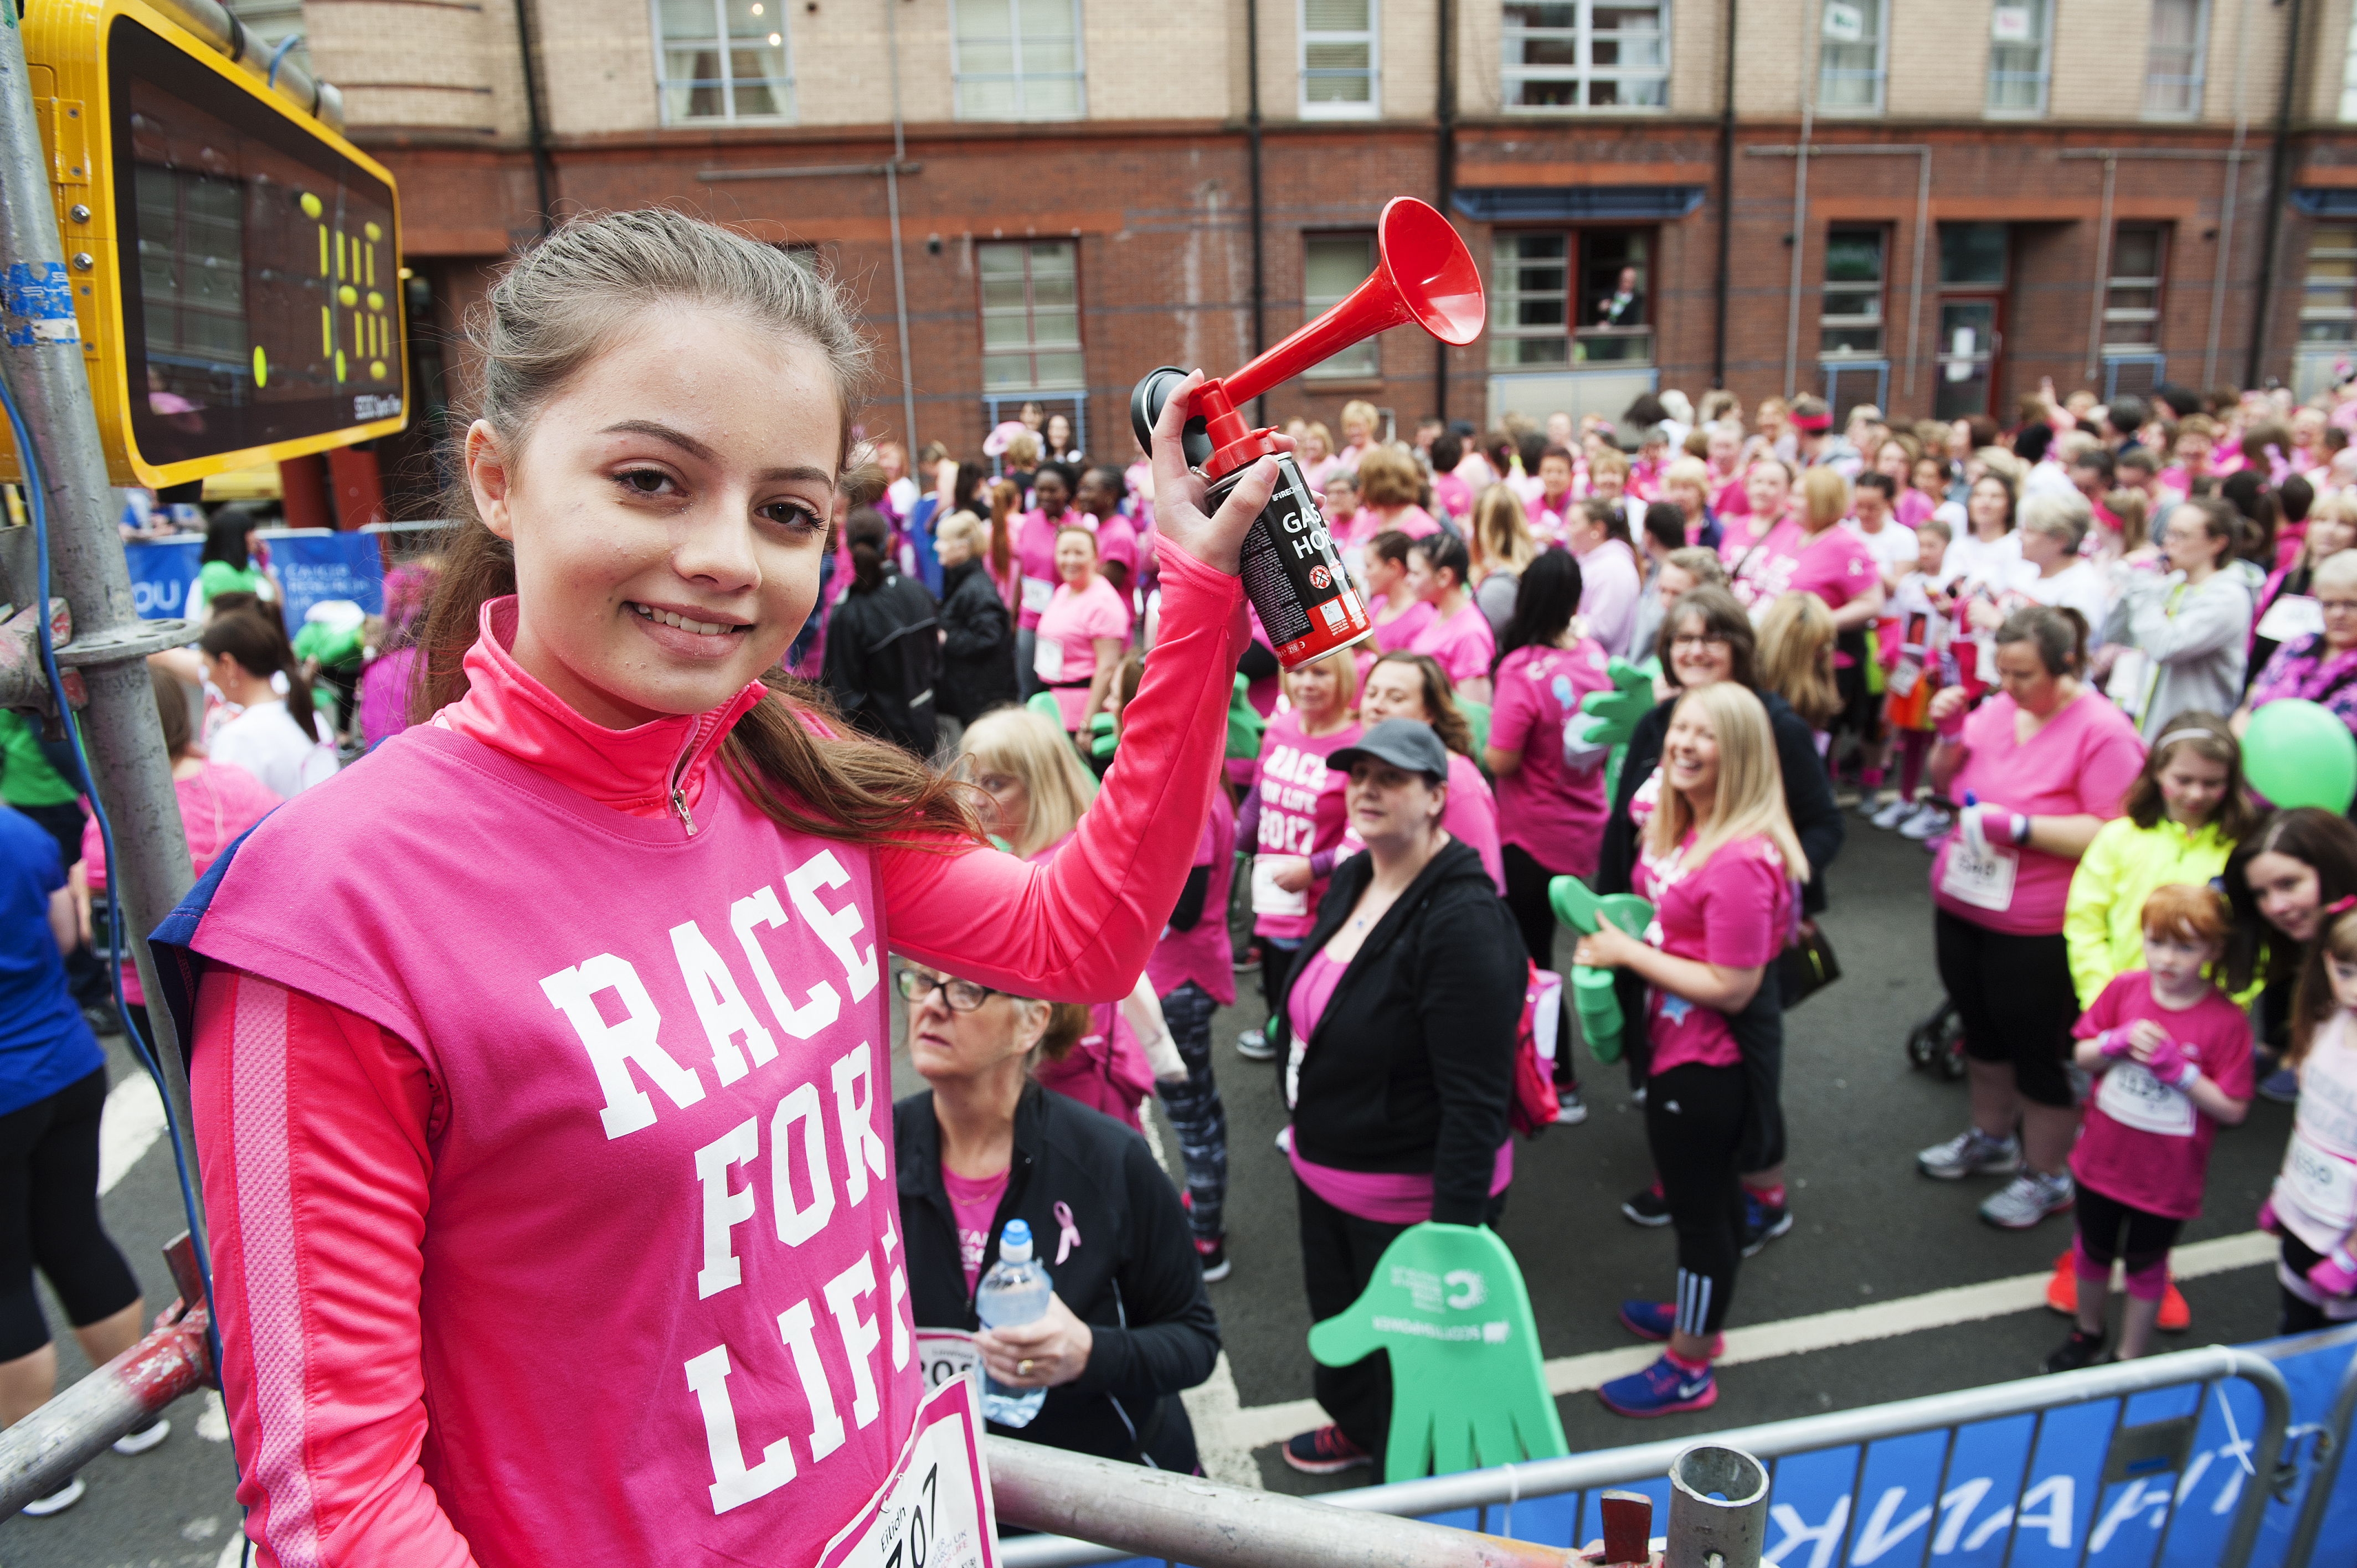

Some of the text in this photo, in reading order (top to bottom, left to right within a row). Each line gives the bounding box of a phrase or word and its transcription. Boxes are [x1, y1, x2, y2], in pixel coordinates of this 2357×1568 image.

[1283, 503, 1321, 533] GAS
[1292, 527, 1334, 559] HOR
[132, 578, 182, 613] OU
[1288, 644, 1298, 653] 210
[1263, 744, 1328, 791] RACE
[1258, 805, 1316, 856] 2017
[539, 848, 880, 1141] RACE
[694, 1040, 887, 1301] FOR
[881, 1507, 906, 1554] Eilidh
